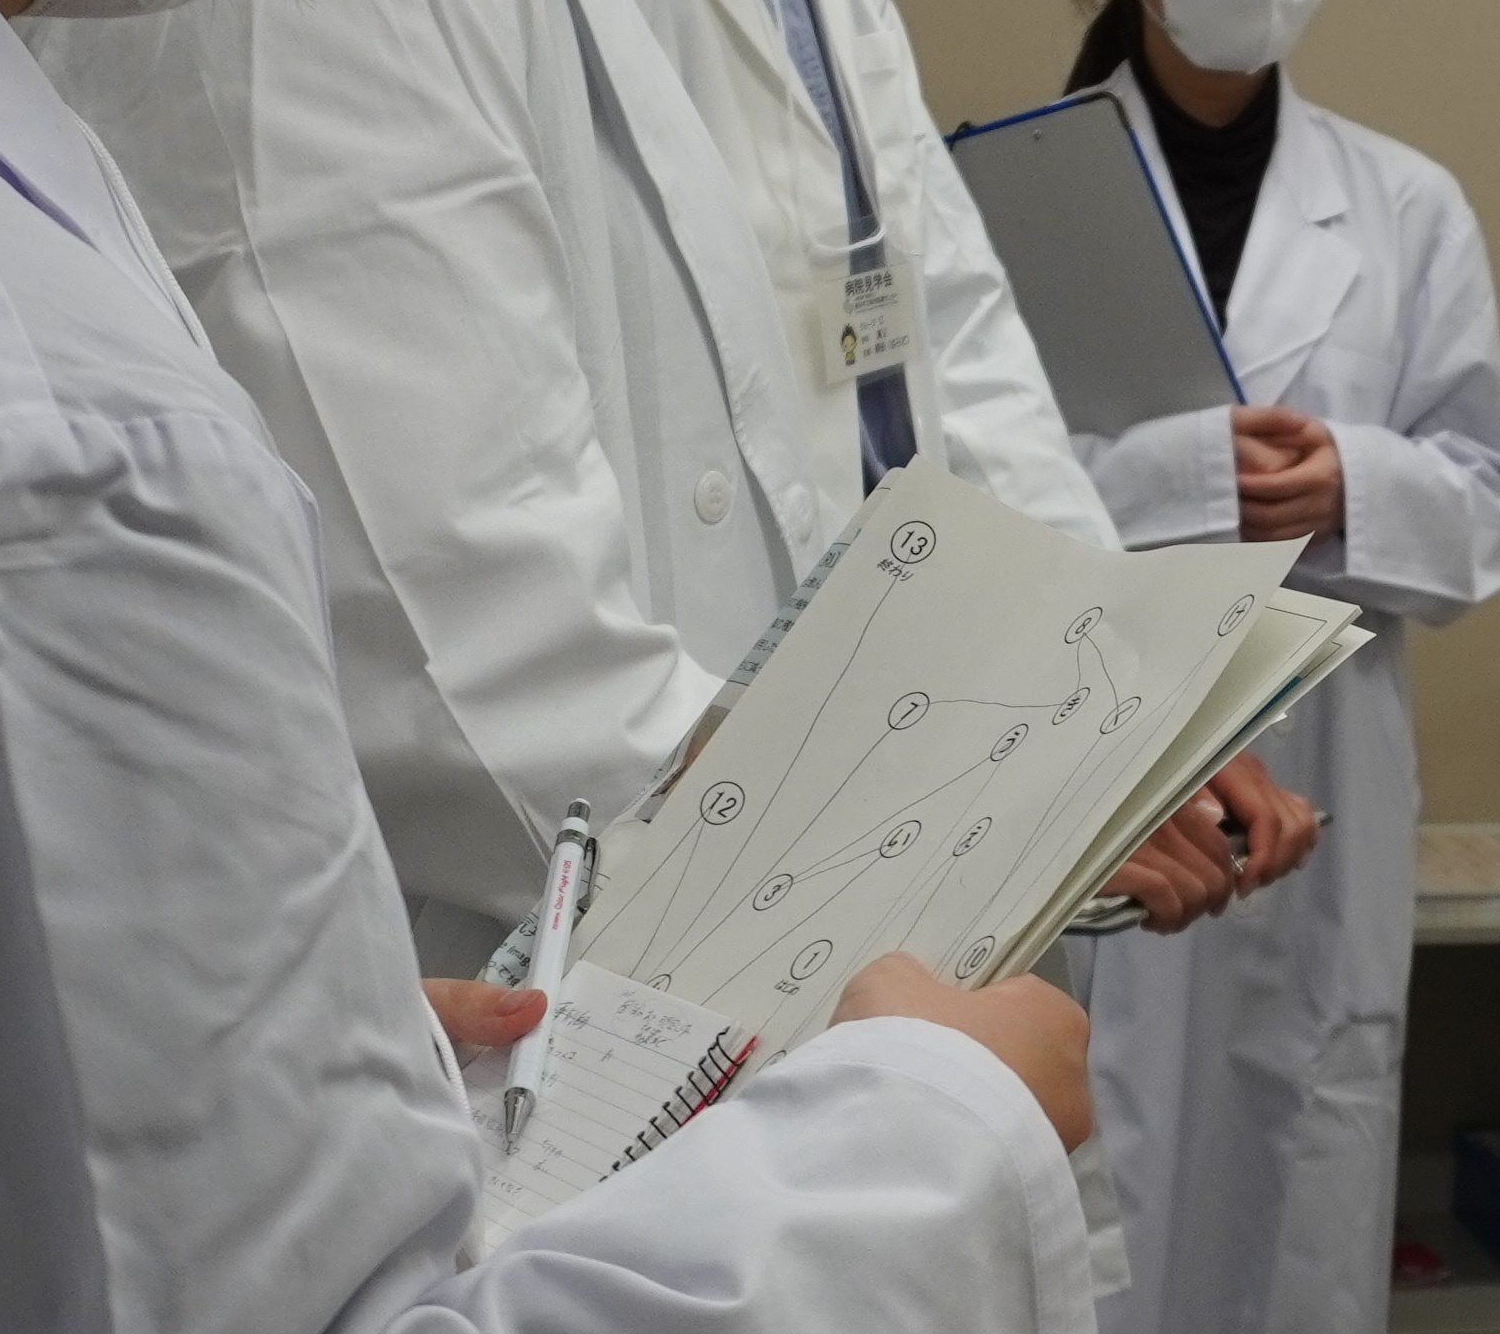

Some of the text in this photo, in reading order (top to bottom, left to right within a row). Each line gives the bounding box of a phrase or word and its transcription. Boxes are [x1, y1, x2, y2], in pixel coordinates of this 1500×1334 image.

[900, 530, 928, 556] 13
[876, 558, 914, 582] 終わり
[707, 791, 737, 818] 12
[965, 947, 988, 968] 10
